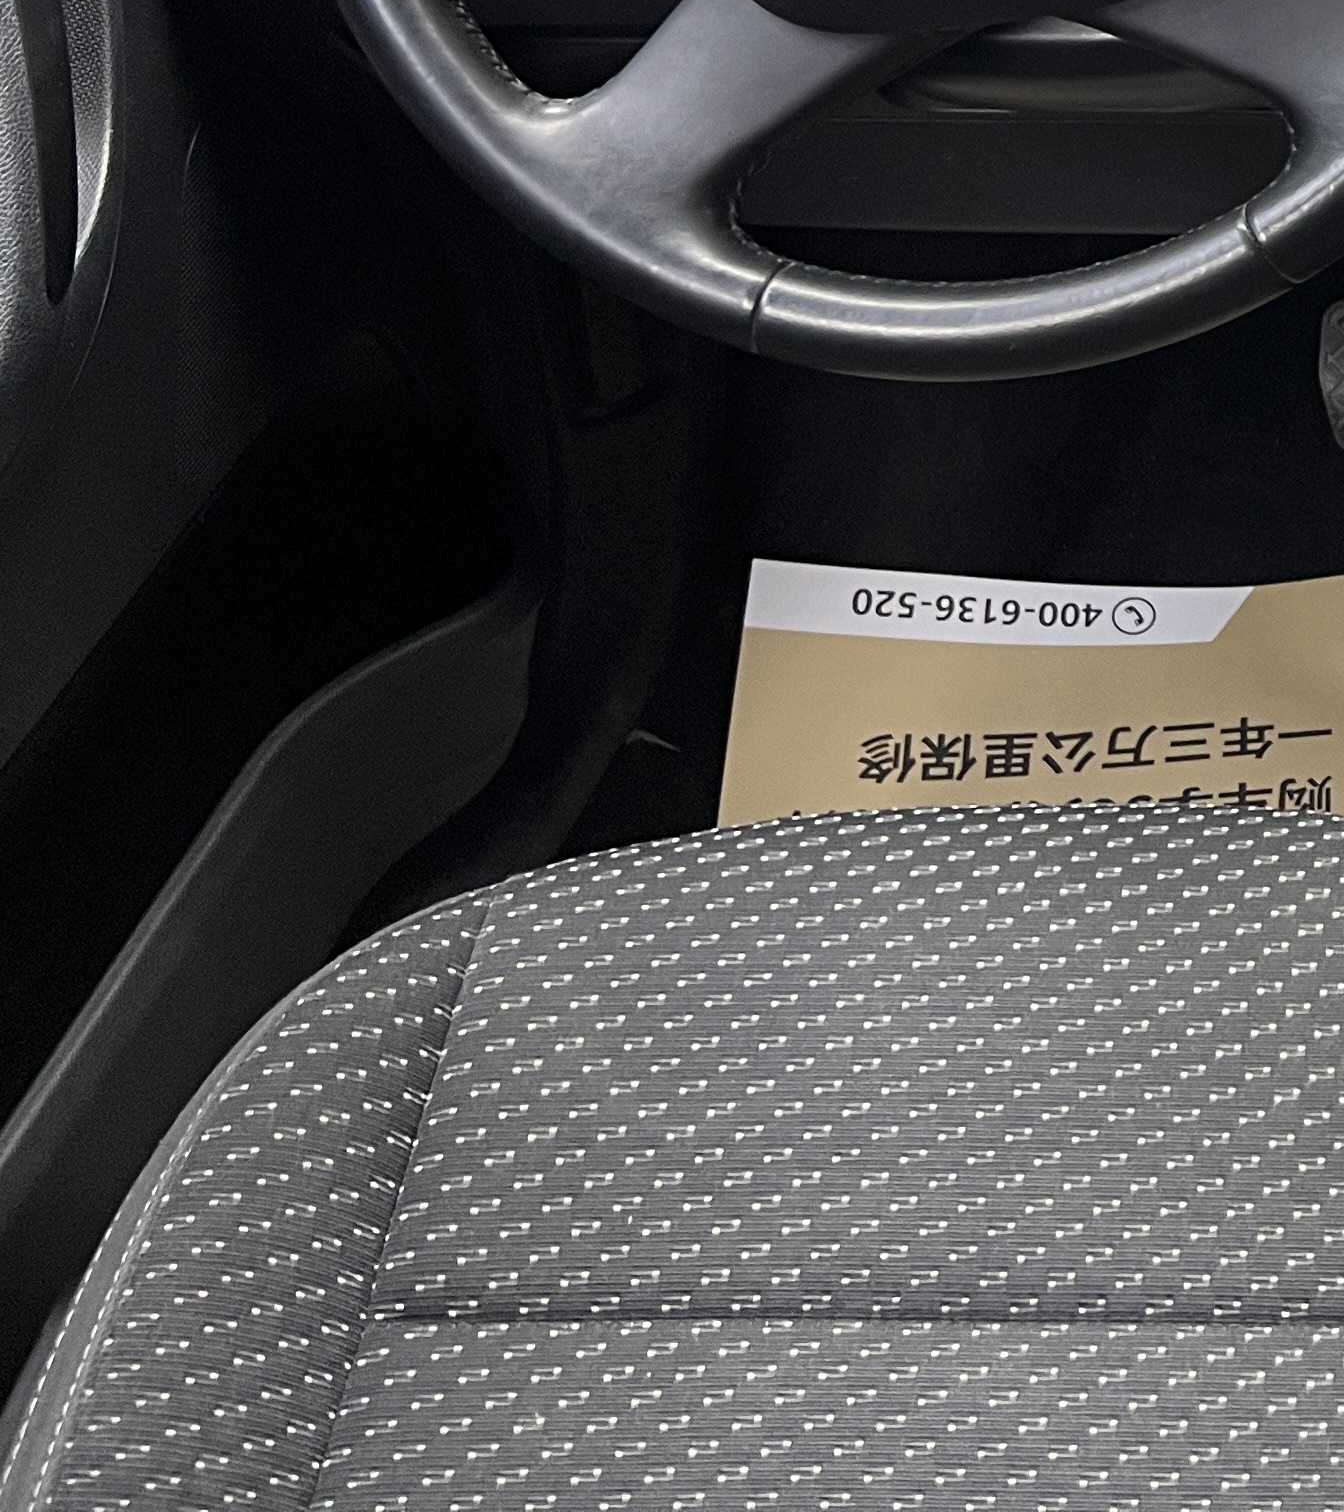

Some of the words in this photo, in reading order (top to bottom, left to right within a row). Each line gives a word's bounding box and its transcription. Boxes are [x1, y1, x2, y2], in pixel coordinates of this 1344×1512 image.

[852, 587, 1103, 629] 400-6136-520
[856, 716, 1333, 785] 一年三万公里保修
